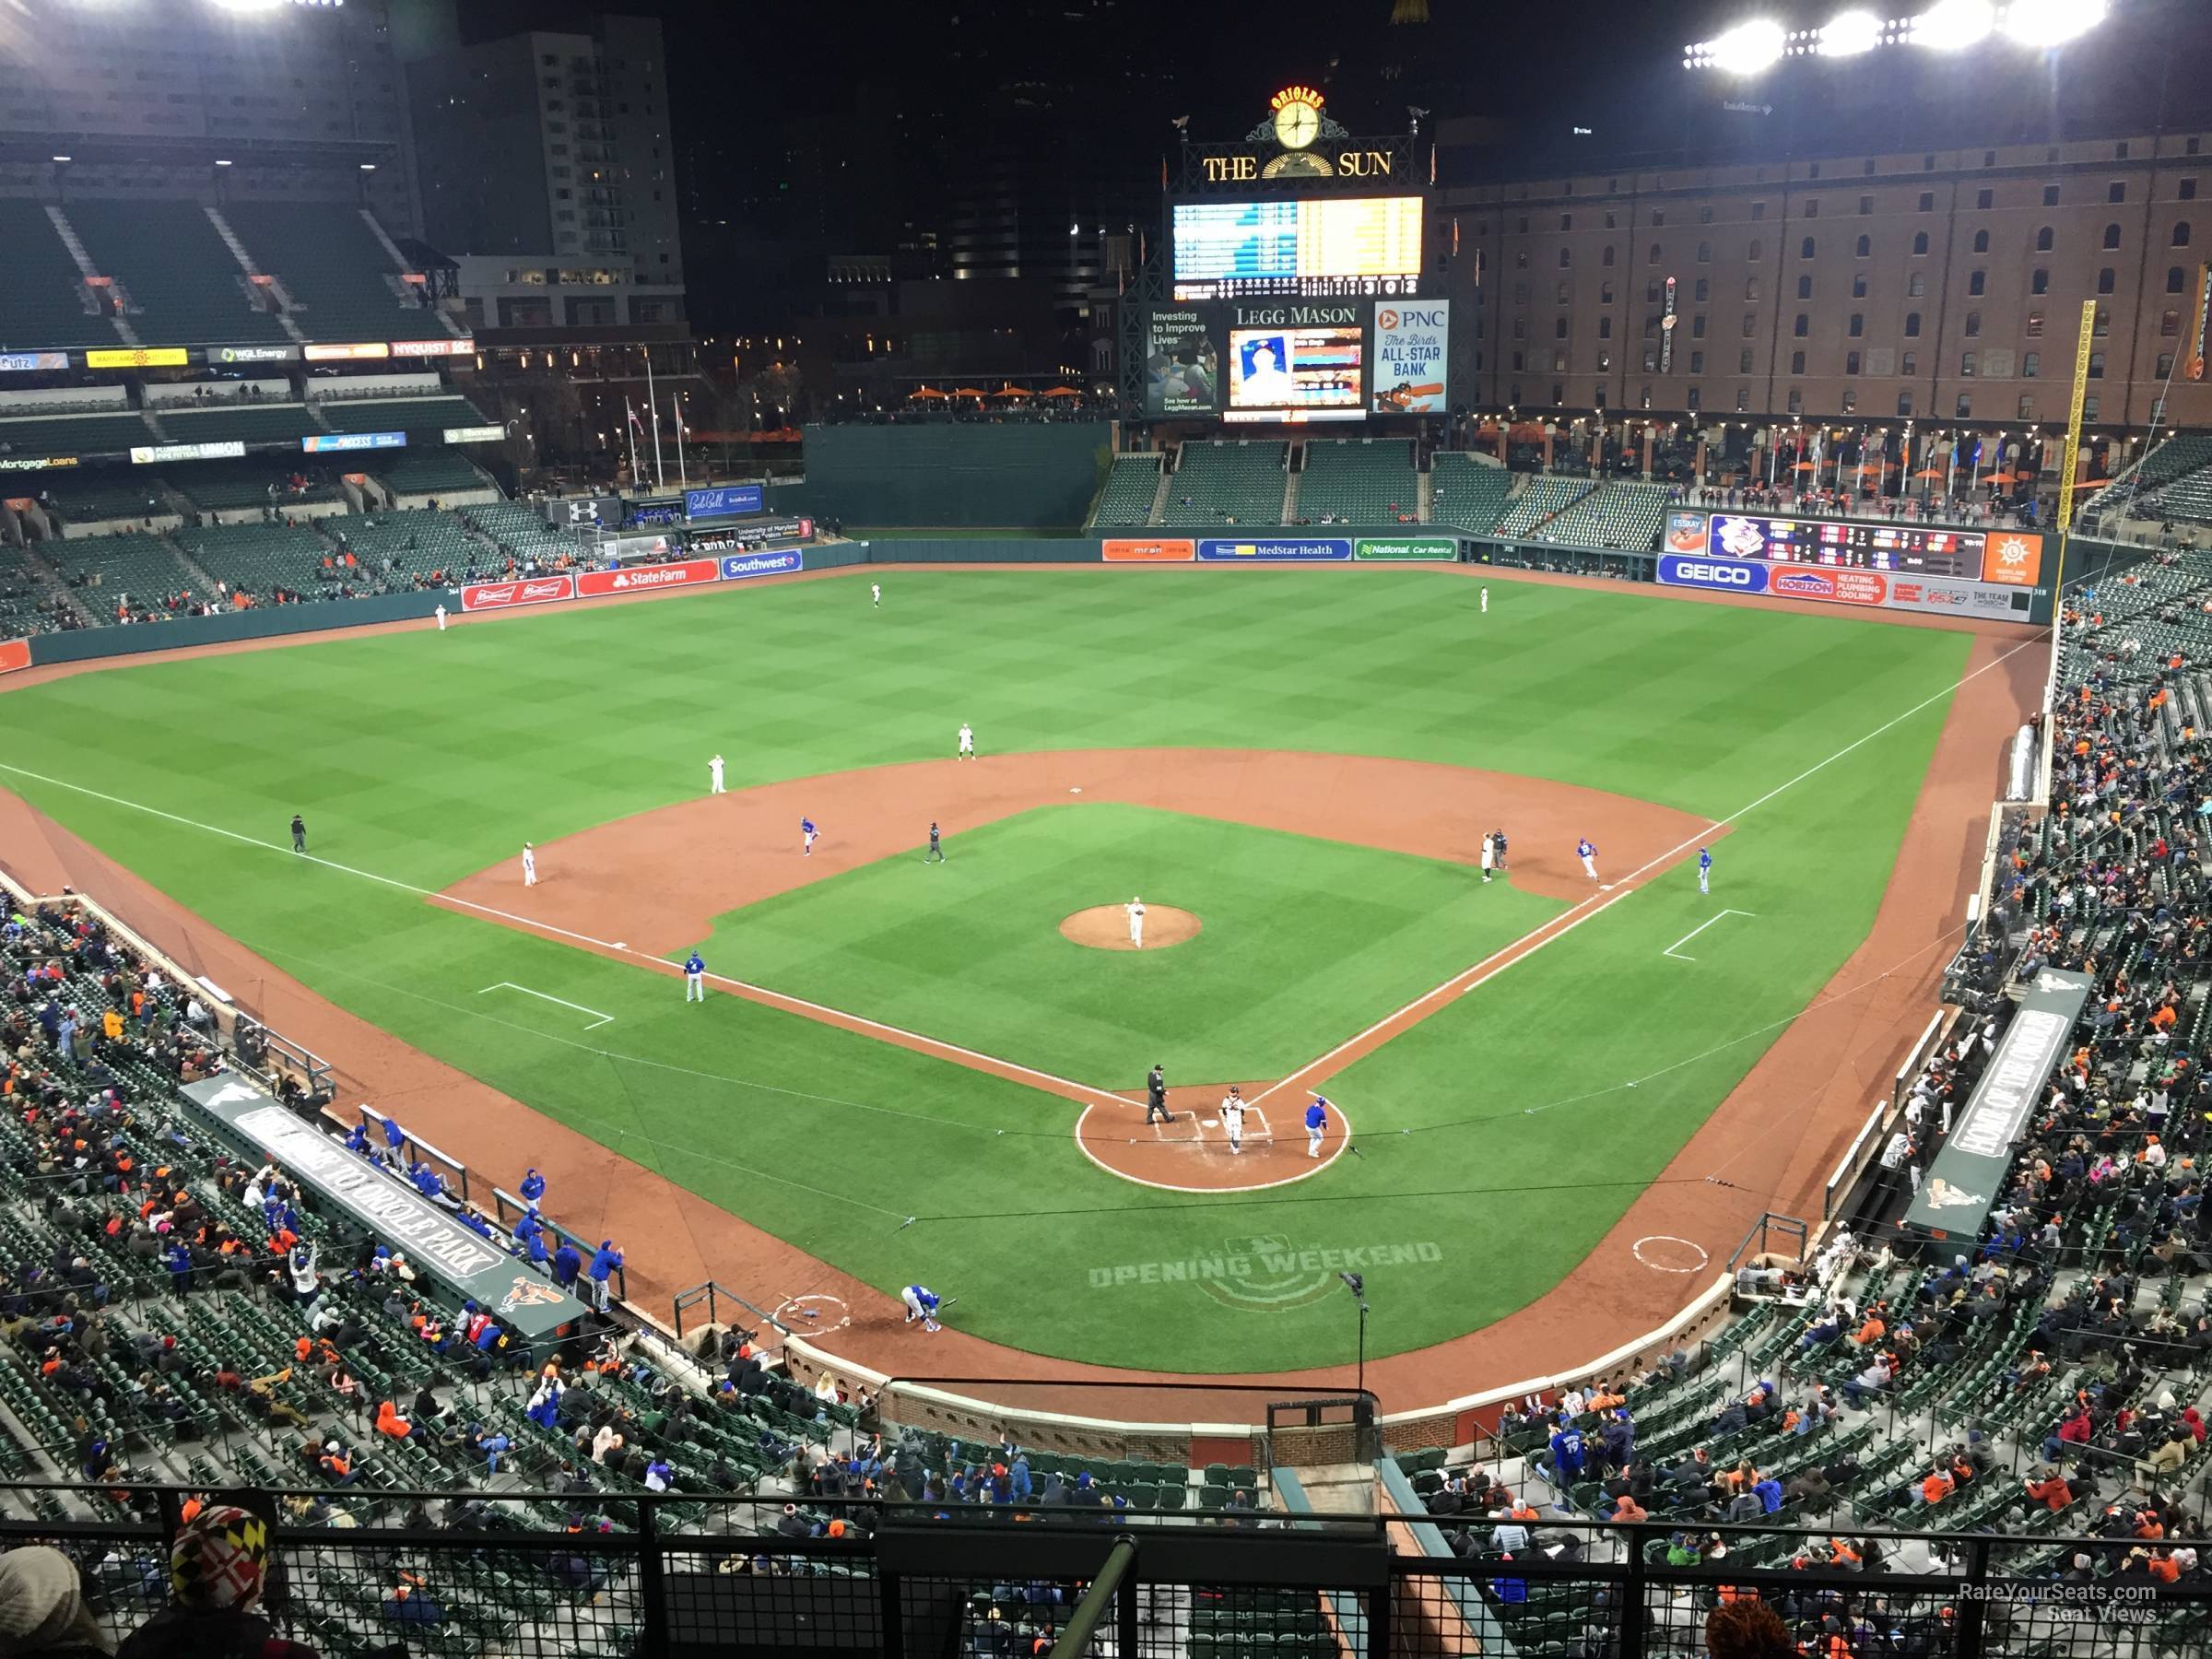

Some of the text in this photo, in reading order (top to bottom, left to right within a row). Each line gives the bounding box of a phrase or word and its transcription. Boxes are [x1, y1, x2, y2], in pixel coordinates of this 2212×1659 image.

[1271, 86, 1324, 109] ORIOLES
[1203, 151, 1393, 182] THE SUN
[1364, 281, 1374, 295] 3
[1385, 281, 1396, 294] 0
[1406, 280, 1417, 294] 2
[1152, 312, 1197, 323] Investing
[1237, 306, 1356, 325] LEGG MASON
[1401, 311, 1445, 327] PNC
[1152, 324, 1206, 335] to Improve
[1385, 334, 1437, 346] The Birds
[235, 349, 287, 359] WGL Energy
[1382, 347, 1441, 361] ALL-STAR
[1394, 362, 1426, 376] BANK
[200, 442, 244, 455] UNION
[1673, 519, 1700, 529] ESSKAY
[738, 526, 766, 536] University
[738, 533, 761, 541] Medical
[1257, 545, 1333, 554] MedStar Health
[1372, 546, 1409, 554] National
[1428, 546, 1452, 554] Rental
[730, 557, 786, 573] Southwest
[1676, 562, 1750, 584] GEICO
[1837, 574, 1875, 584] HEATING
[1778, 579, 1832, 593] HORIZON
[1837, 582, 1880, 594] PLUMBING
[1836, 590, 1874, 601] COOLING
[1974, 592, 2008, 602] THE TEAM
[323, 1163, 368, 1188] TO
[352, 1183, 439, 1236] ORIOLE
[417, 1228, 494, 1274] PARK
[1088, 1242, 1443, 1288] OPENING WEEKEND
[1566, 1441, 1579, 1453] 19
